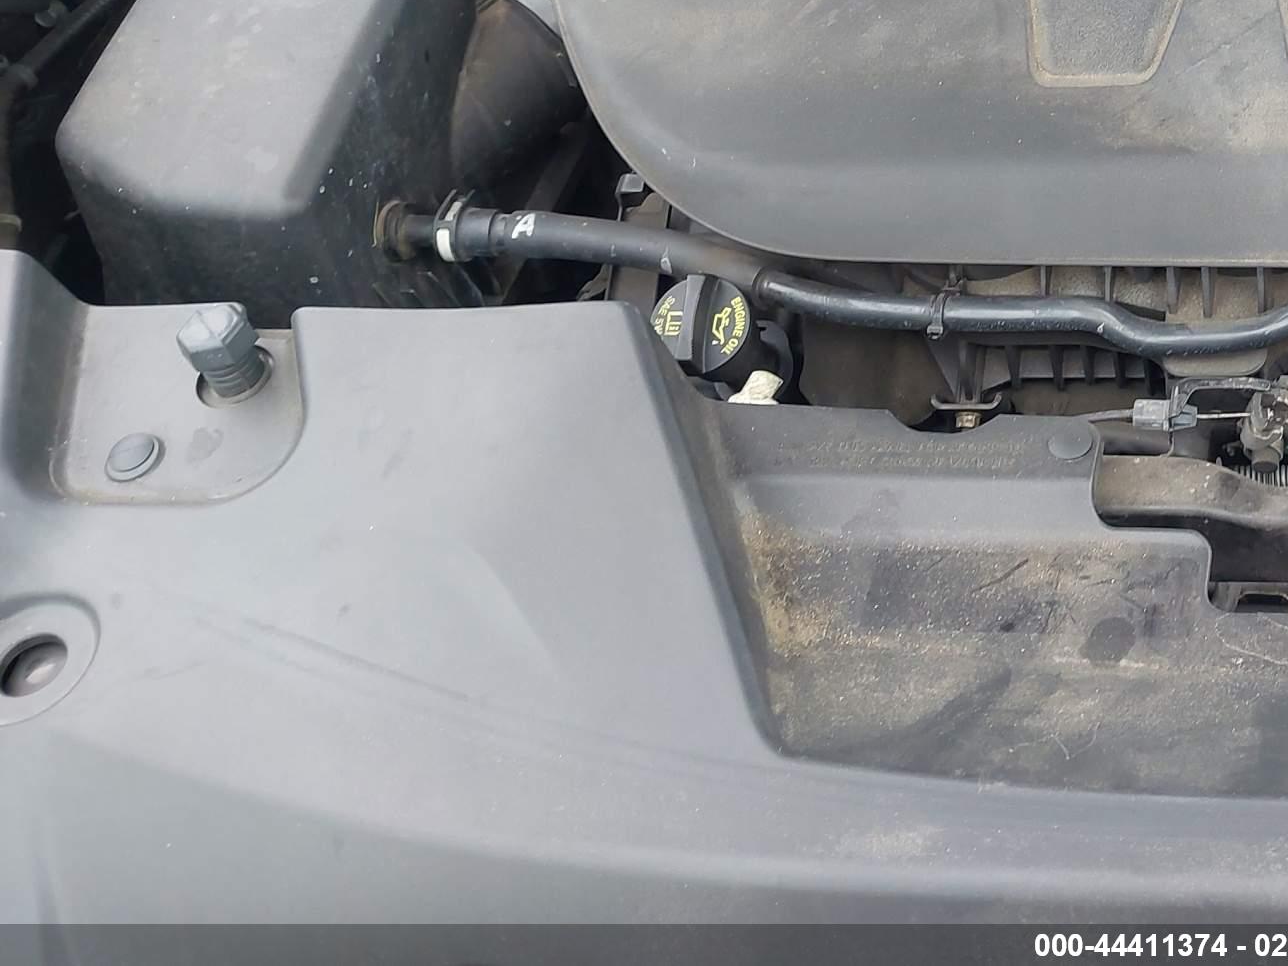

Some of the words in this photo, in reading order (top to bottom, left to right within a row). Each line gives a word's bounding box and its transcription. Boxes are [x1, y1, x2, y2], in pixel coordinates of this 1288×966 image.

[658, 295, 675, 316] SAE
[730, 296, 746, 338] ENGINE
[720, 338, 739, 356] OIL
